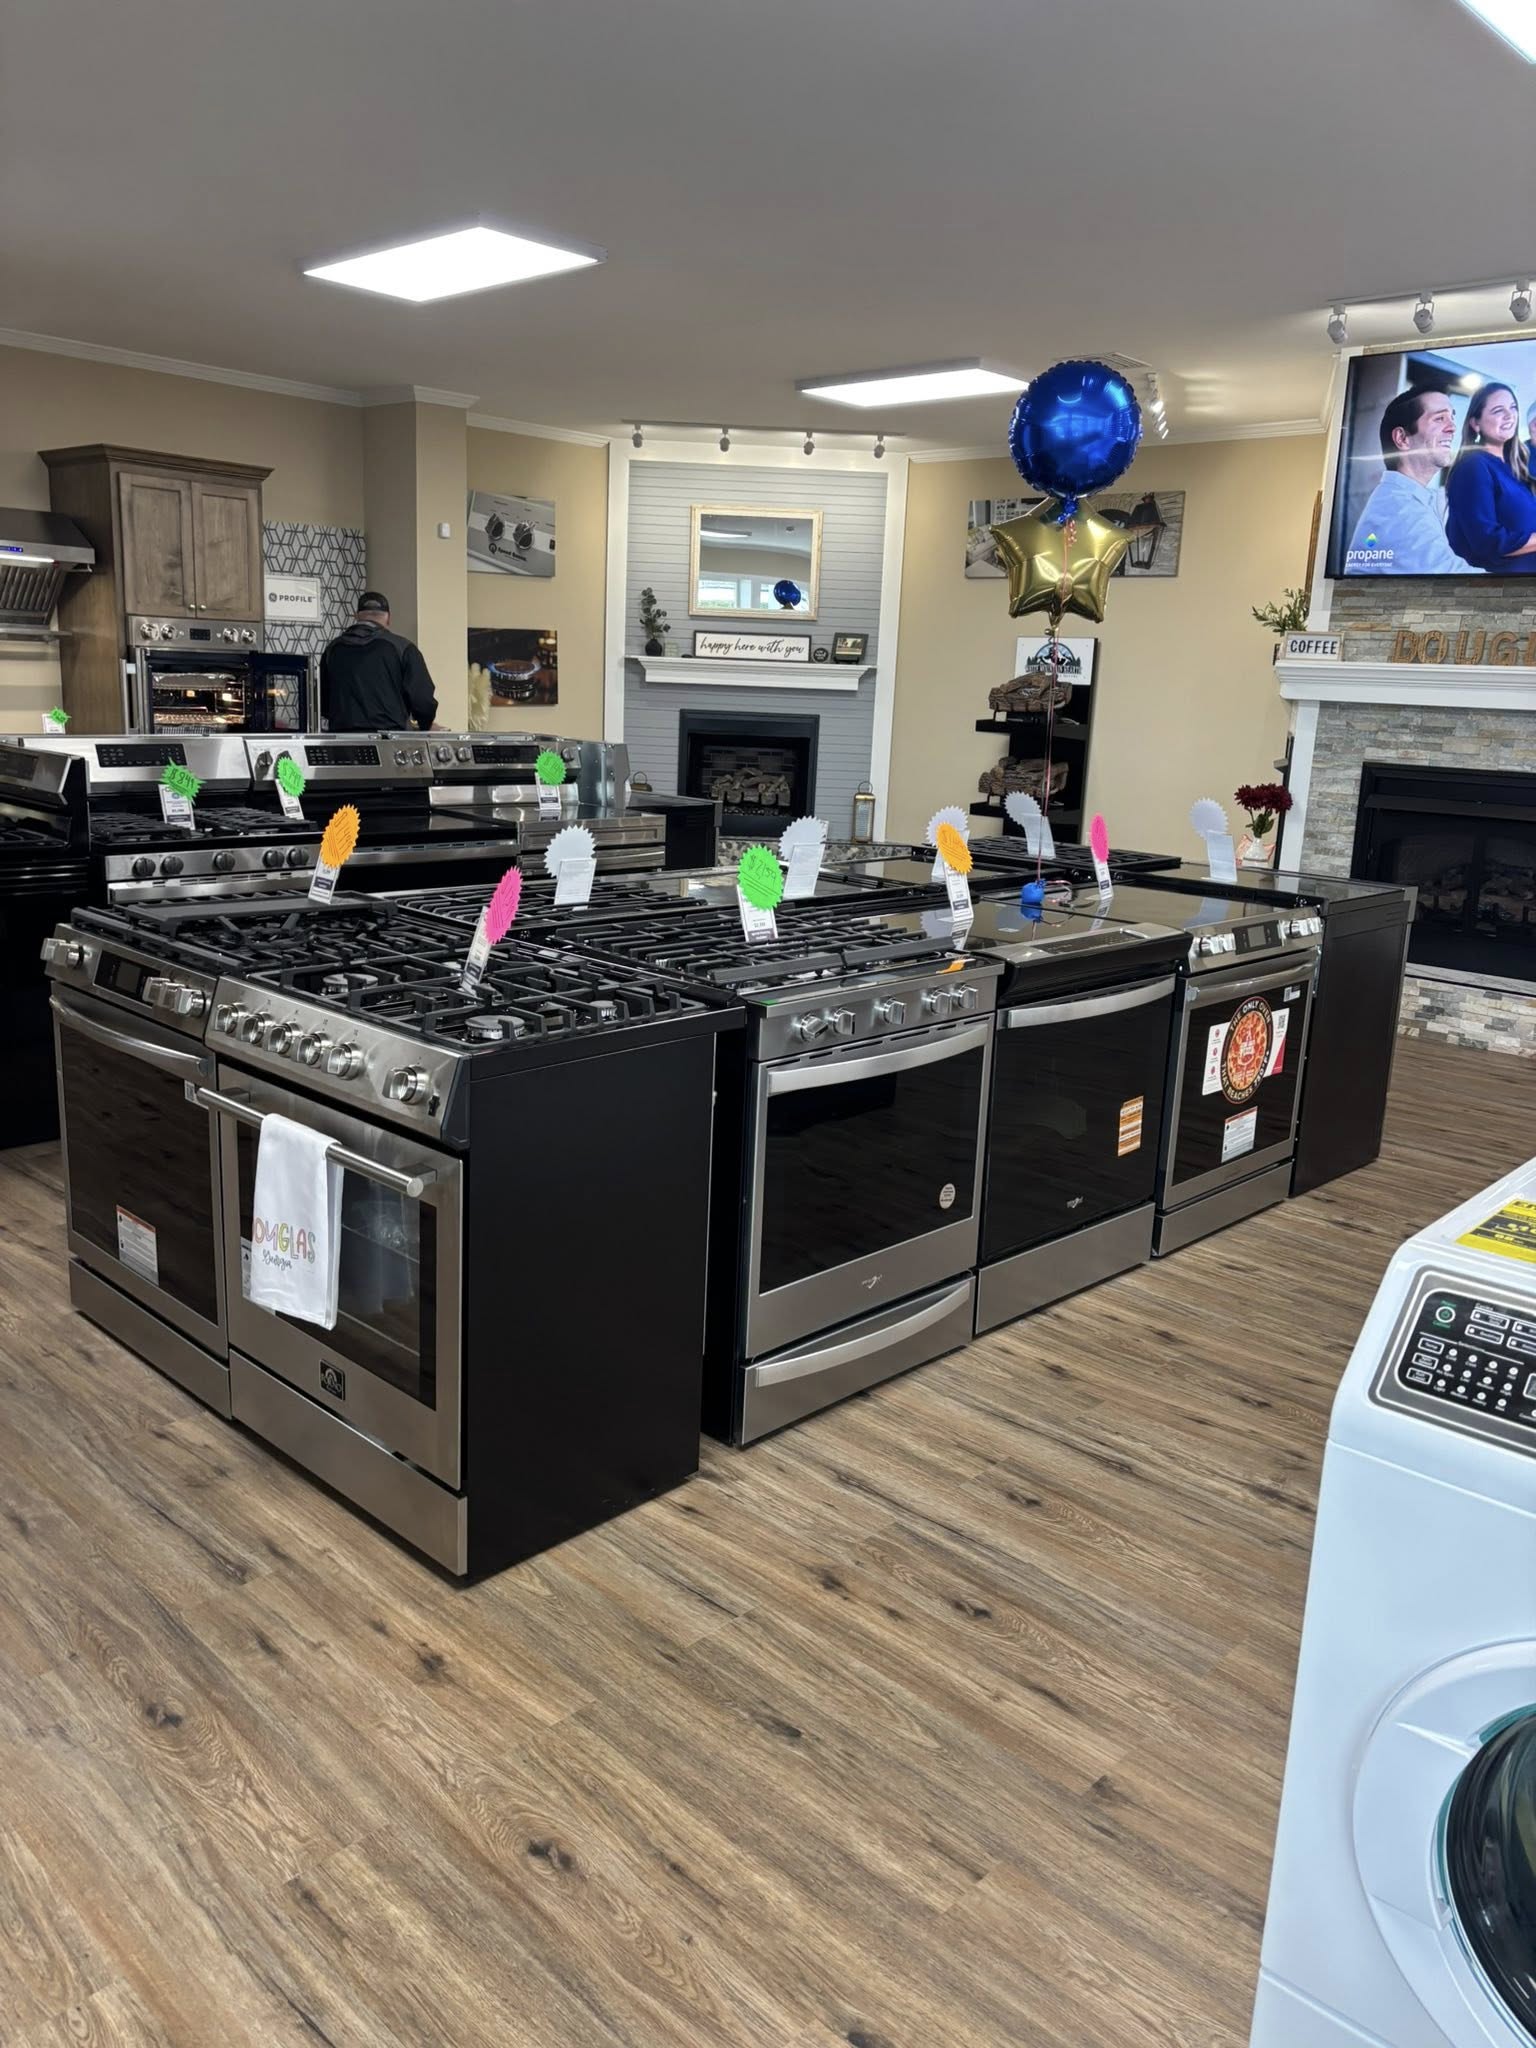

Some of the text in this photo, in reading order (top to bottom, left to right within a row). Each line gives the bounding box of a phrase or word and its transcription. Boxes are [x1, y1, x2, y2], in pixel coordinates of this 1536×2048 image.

[1346, 549, 1395, 563] propane
[279, 594, 313, 603] PROFILE
[700, 636, 732, 655] happy
[734, 638, 757, 651] here
[757, 639, 784, 654] with
[784, 645, 805, 658] you
[1290, 639, 1339, 655] COFFEE
[1242, 1000, 1259, 1013] ONLY
[1258, 1002, 1272, 1023] OVEN
[1226, 1086, 1254, 1101] REACHES
